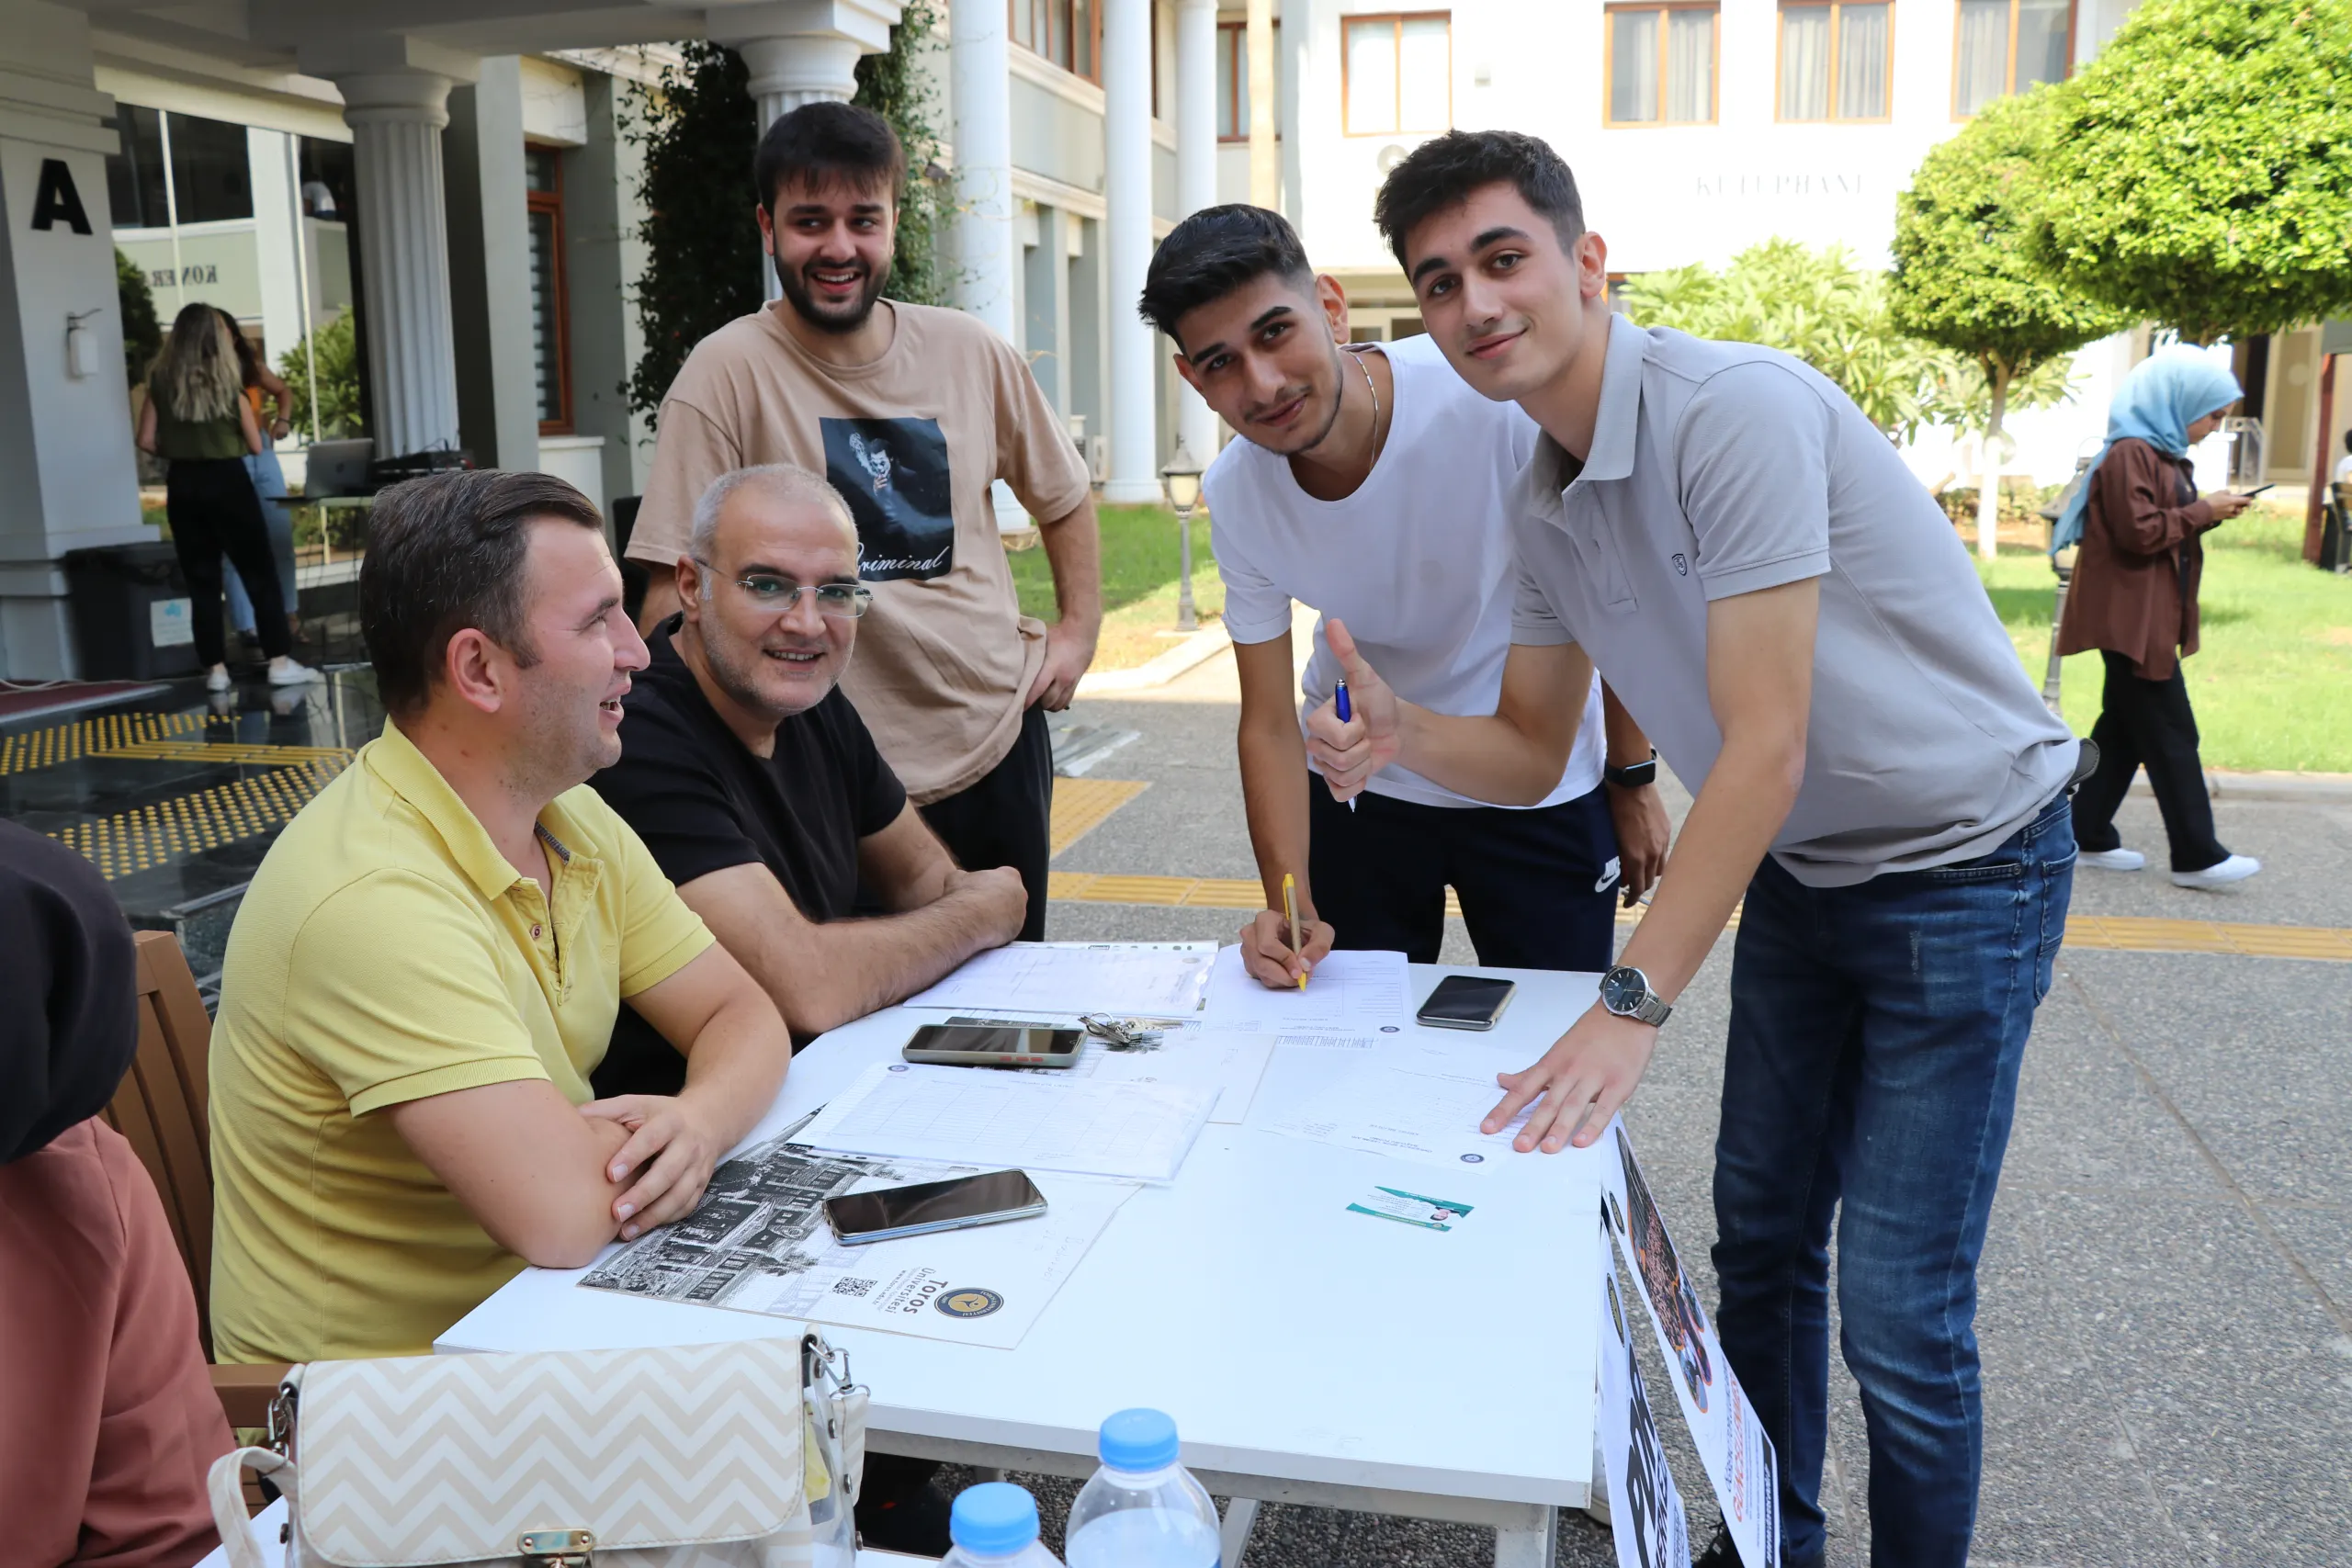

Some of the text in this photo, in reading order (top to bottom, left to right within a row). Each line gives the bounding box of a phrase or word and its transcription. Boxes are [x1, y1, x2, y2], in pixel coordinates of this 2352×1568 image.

[31, 158, 93, 235] A
[884, 1267, 936, 1314] Üniversitesi
[903, 1280, 949, 1314] Toros
